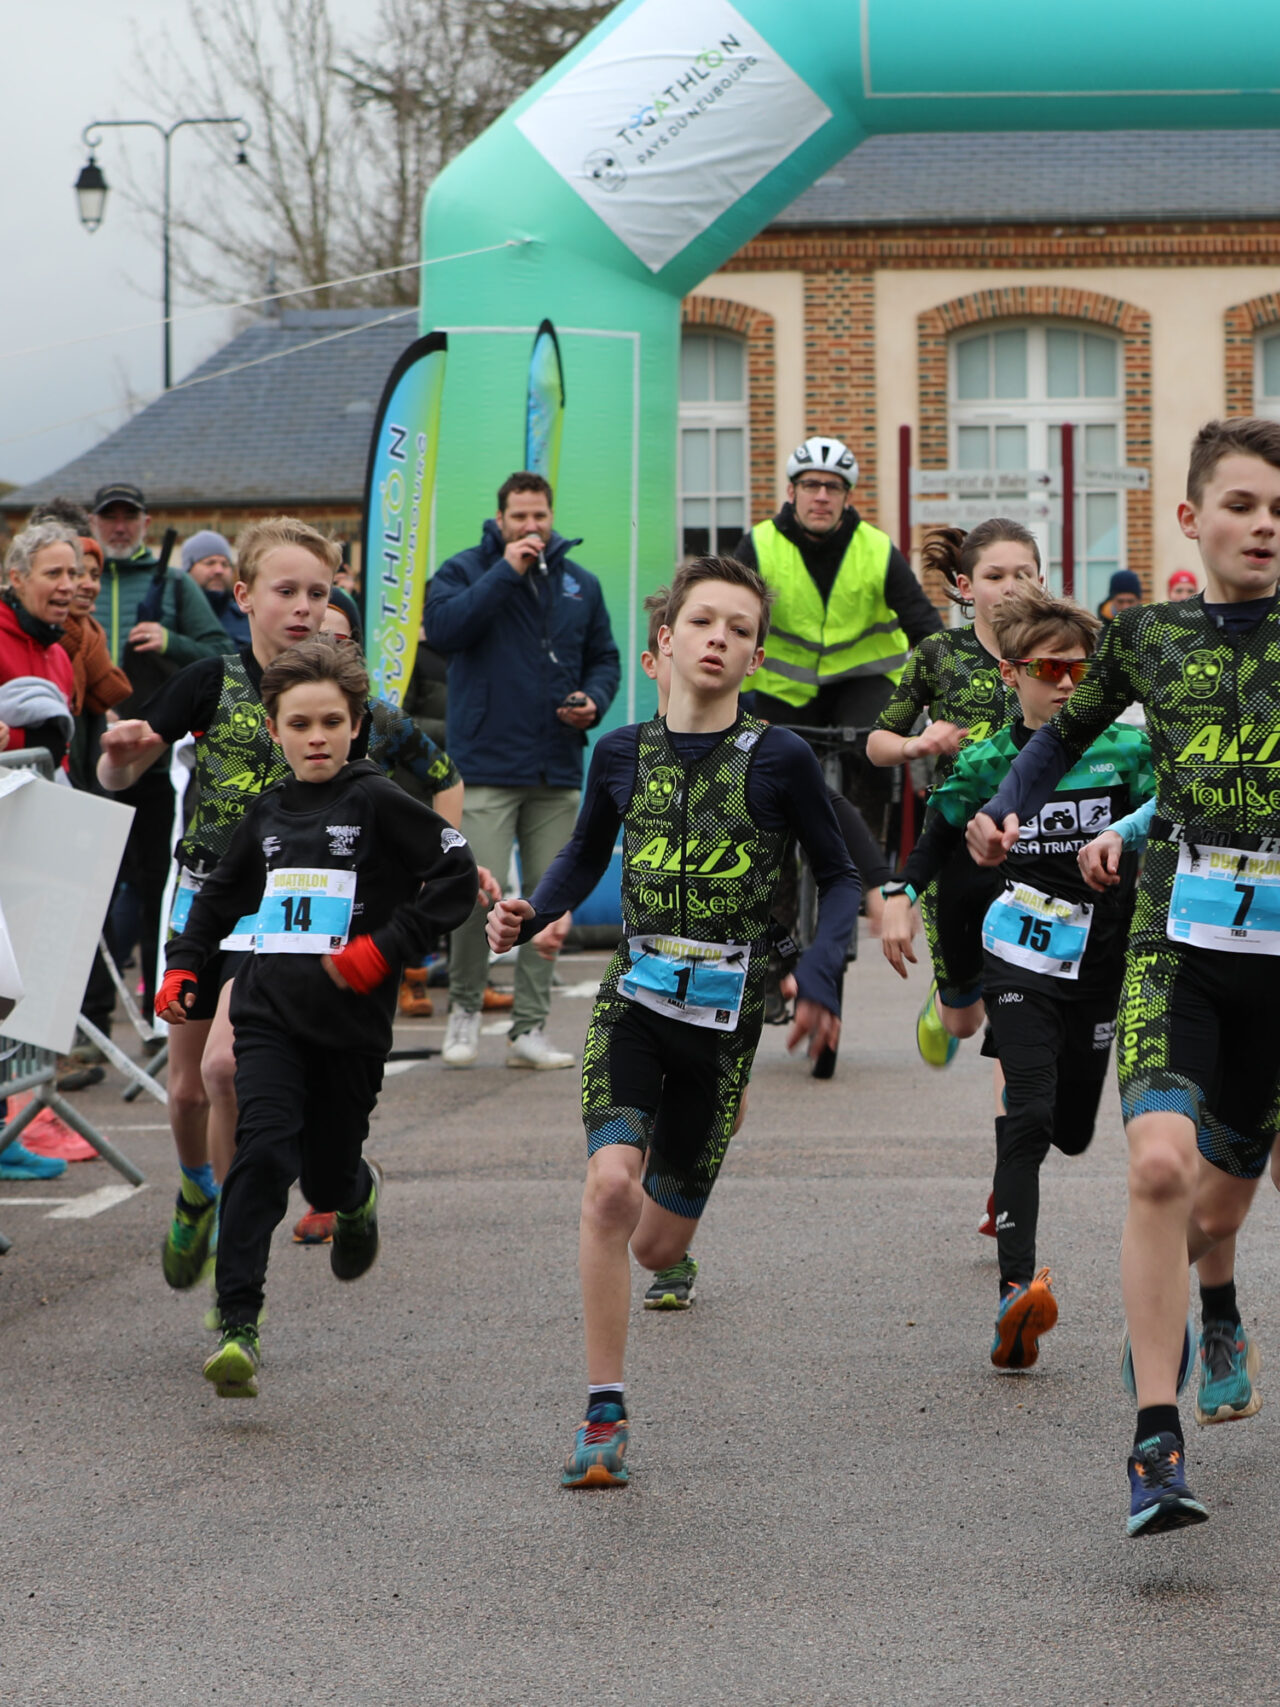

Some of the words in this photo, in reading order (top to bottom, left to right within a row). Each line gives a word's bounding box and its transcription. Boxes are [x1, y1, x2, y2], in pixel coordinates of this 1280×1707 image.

[637, 134, 669, 165] PAYS
[668, 116, 688, 138] DU
[688, 55, 758, 119] NEUBOURG
[280, 896, 312, 932] 14
[1232, 883, 1255, 926] 7
[1018, 915, 1053, 952] 15
[673, 966, 692, 1001] 1
